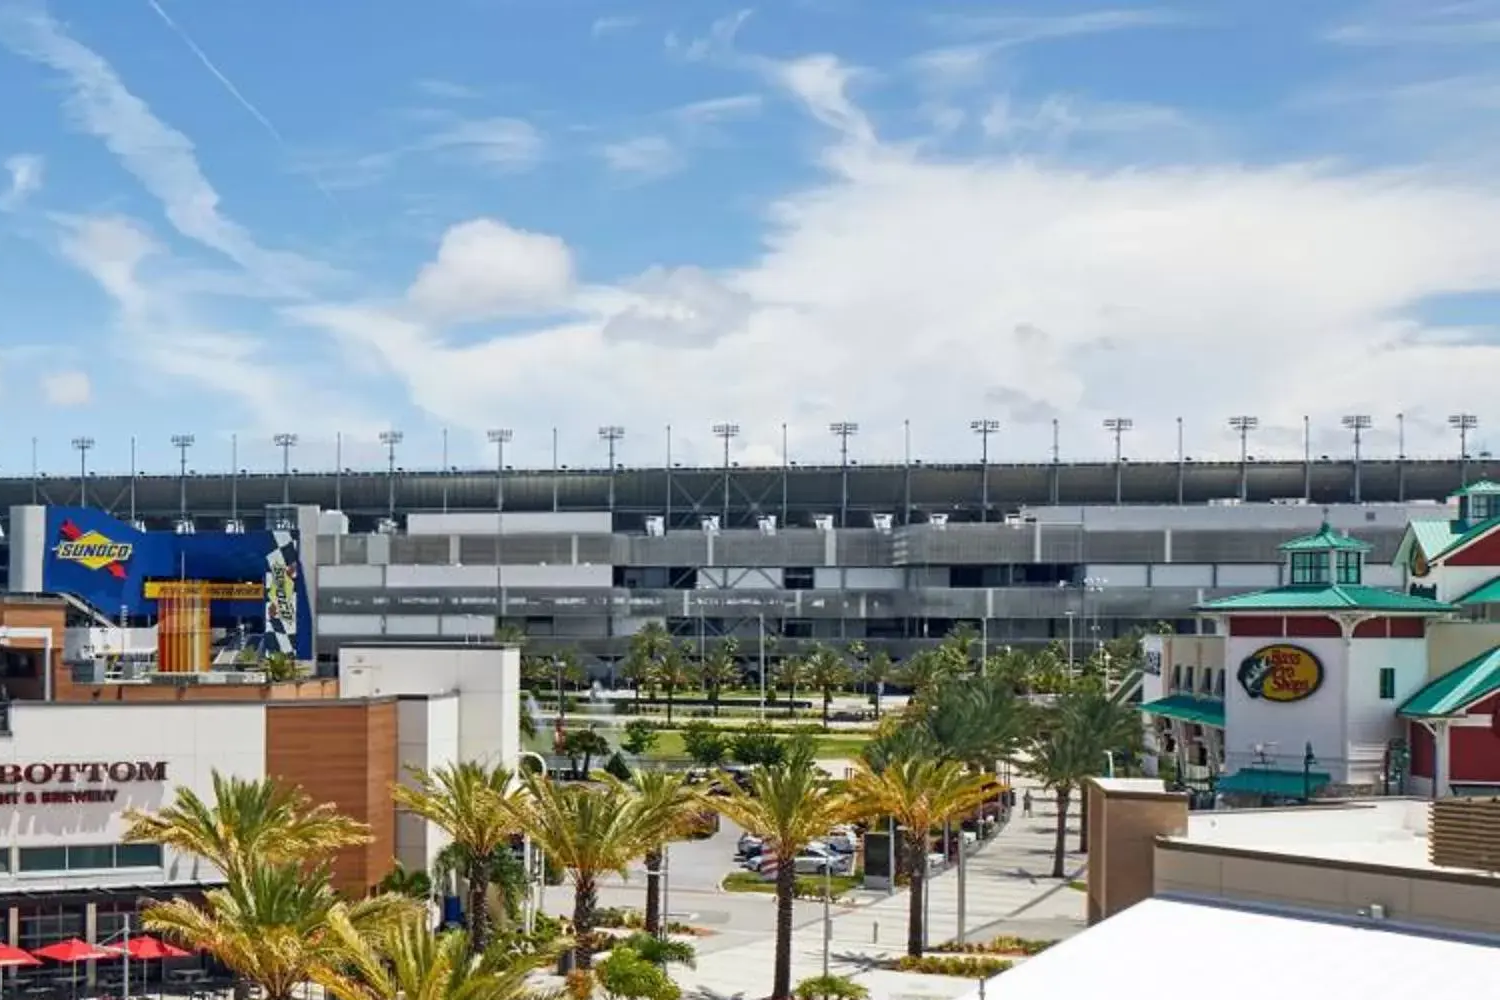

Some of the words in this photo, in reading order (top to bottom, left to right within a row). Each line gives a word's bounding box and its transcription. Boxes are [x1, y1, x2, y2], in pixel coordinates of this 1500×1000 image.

[61, 543, 129, 557] SUNOCO
[25, 791, 38, 804] &
[41, 789, 118, 804] BREWERY
